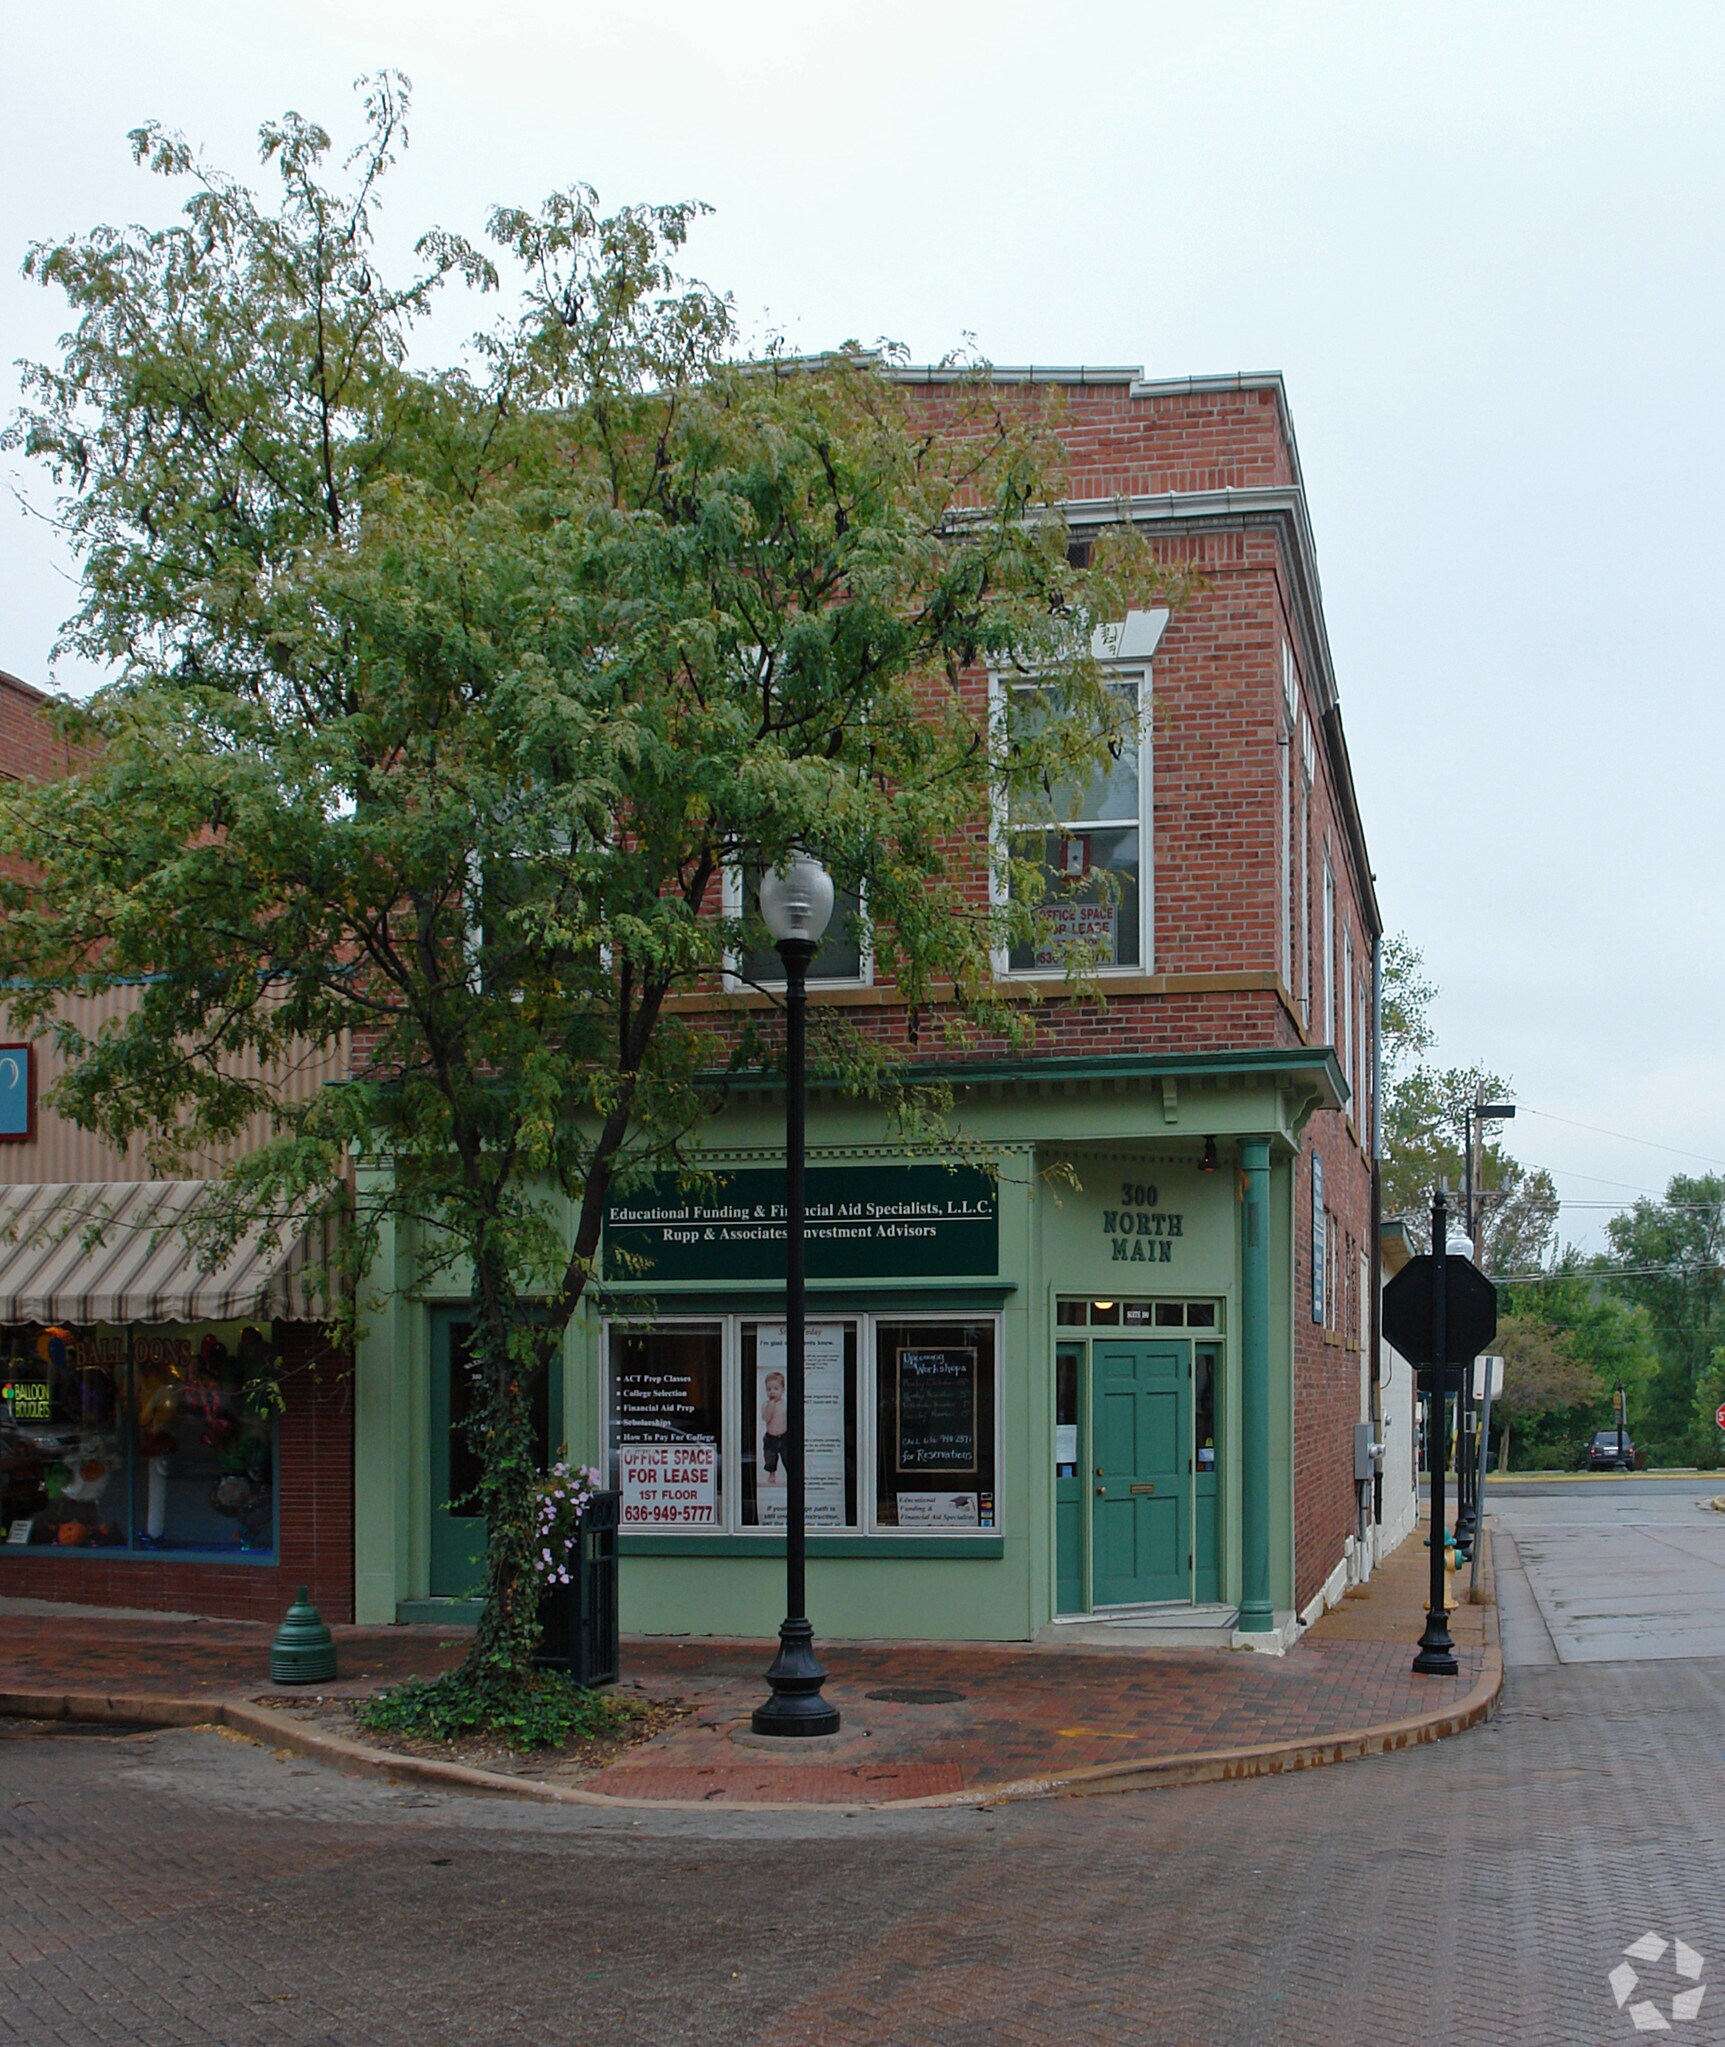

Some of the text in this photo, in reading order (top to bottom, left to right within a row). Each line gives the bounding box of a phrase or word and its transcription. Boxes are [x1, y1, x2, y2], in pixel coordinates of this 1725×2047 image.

[1080, 907, 1113, 920] SPACE
[1121, 1183, 1158, 1207] 300
[609, 1200, 992, 1220] Educational Funding & Fincial Aid Specialists, L.L.C.
[1103, 1211, 1184, 1237] NORTH
[662, 1224, 937, 1243] Rupp & Associates nvestment Advisors
[1111, 1238, 1173, 1263] MAIN
[74, 1337, 192, 1367] BALLOONS
[914, 1363, 967, 1377] Workshops
[623, 1374, 691, 1384] ACT Prep Classes
[15, 1383, 50, 1400] BALLOON
[623, 1389, 688, 1398] College Selection
[15, 1401, 50, 1418] BOUQUETS
[676, 1404, 695, 1413] Prep
[622, 1419, 671, 1428] Scholarships
[654, 1433, 668, 1442] Pay
[686, 1433, 715, 1442] College
[624, 1449, 712, 1465] OFFICE SPACE
[902, 1449, 973, 1463] for Reservations
[628, 1468, 708, 1483] FOR LEASE
[639, 1490, 697, 1500] 1ST FLOOR
[625, 1505, 712, 1521] 636-949-5777
